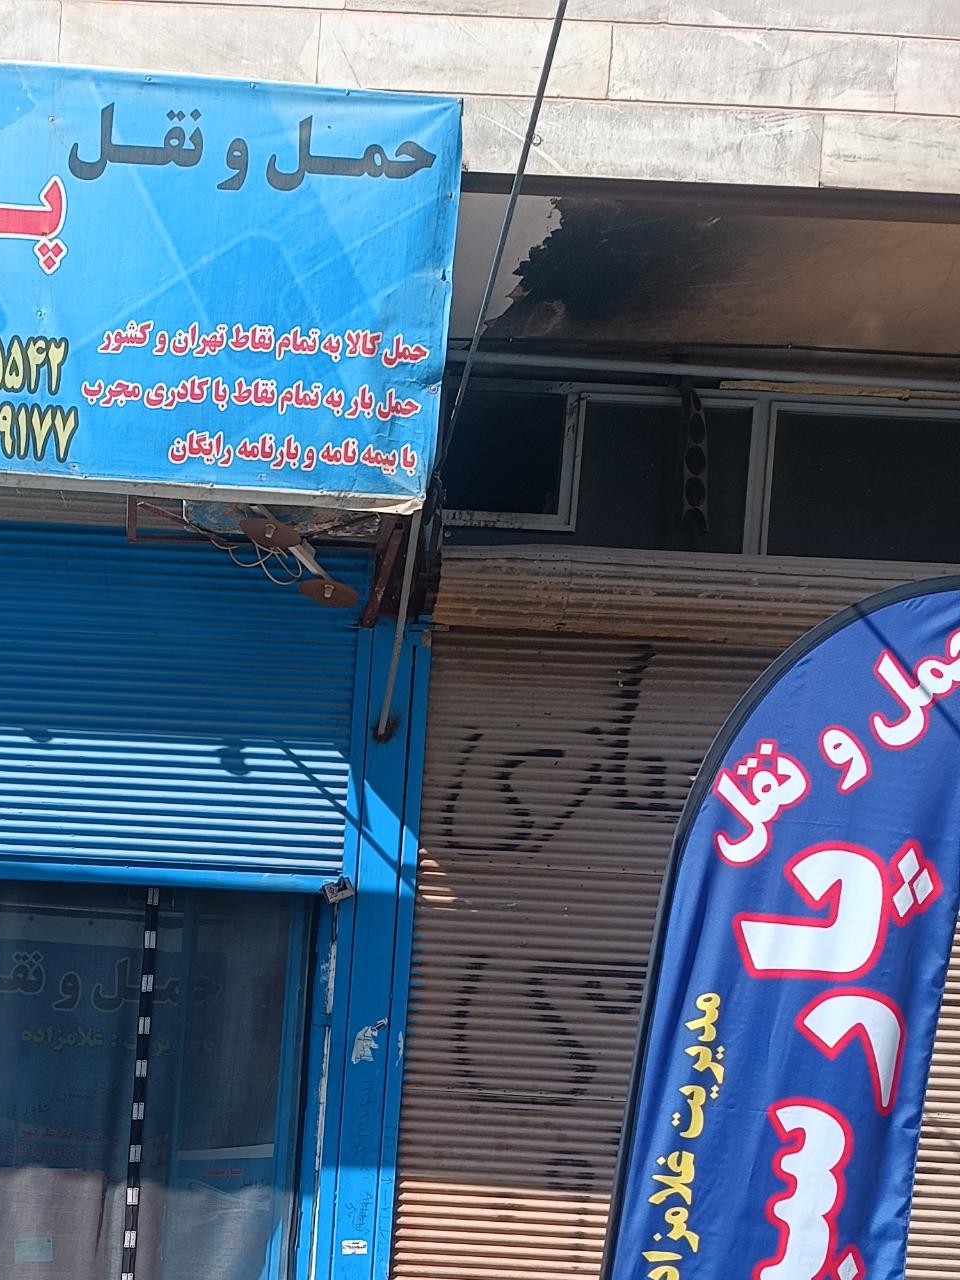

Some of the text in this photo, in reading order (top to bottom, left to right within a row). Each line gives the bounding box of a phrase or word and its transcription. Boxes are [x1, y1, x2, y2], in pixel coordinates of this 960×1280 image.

[68, 103, 437, 192] حمل و نقل
[98, 320, 429, 367] حمل کالا به تمام نقاط تهران و کشور
[81, 375, 421, 420] حمل بار به تمام نقاط با کادری مجرب
[168, 429, 417, 476] با بیمه نامه و بارنامه رایگان
[712, 630, 960, 866] مل و نقل
[671, 991, 725, 1139] مدیریت
